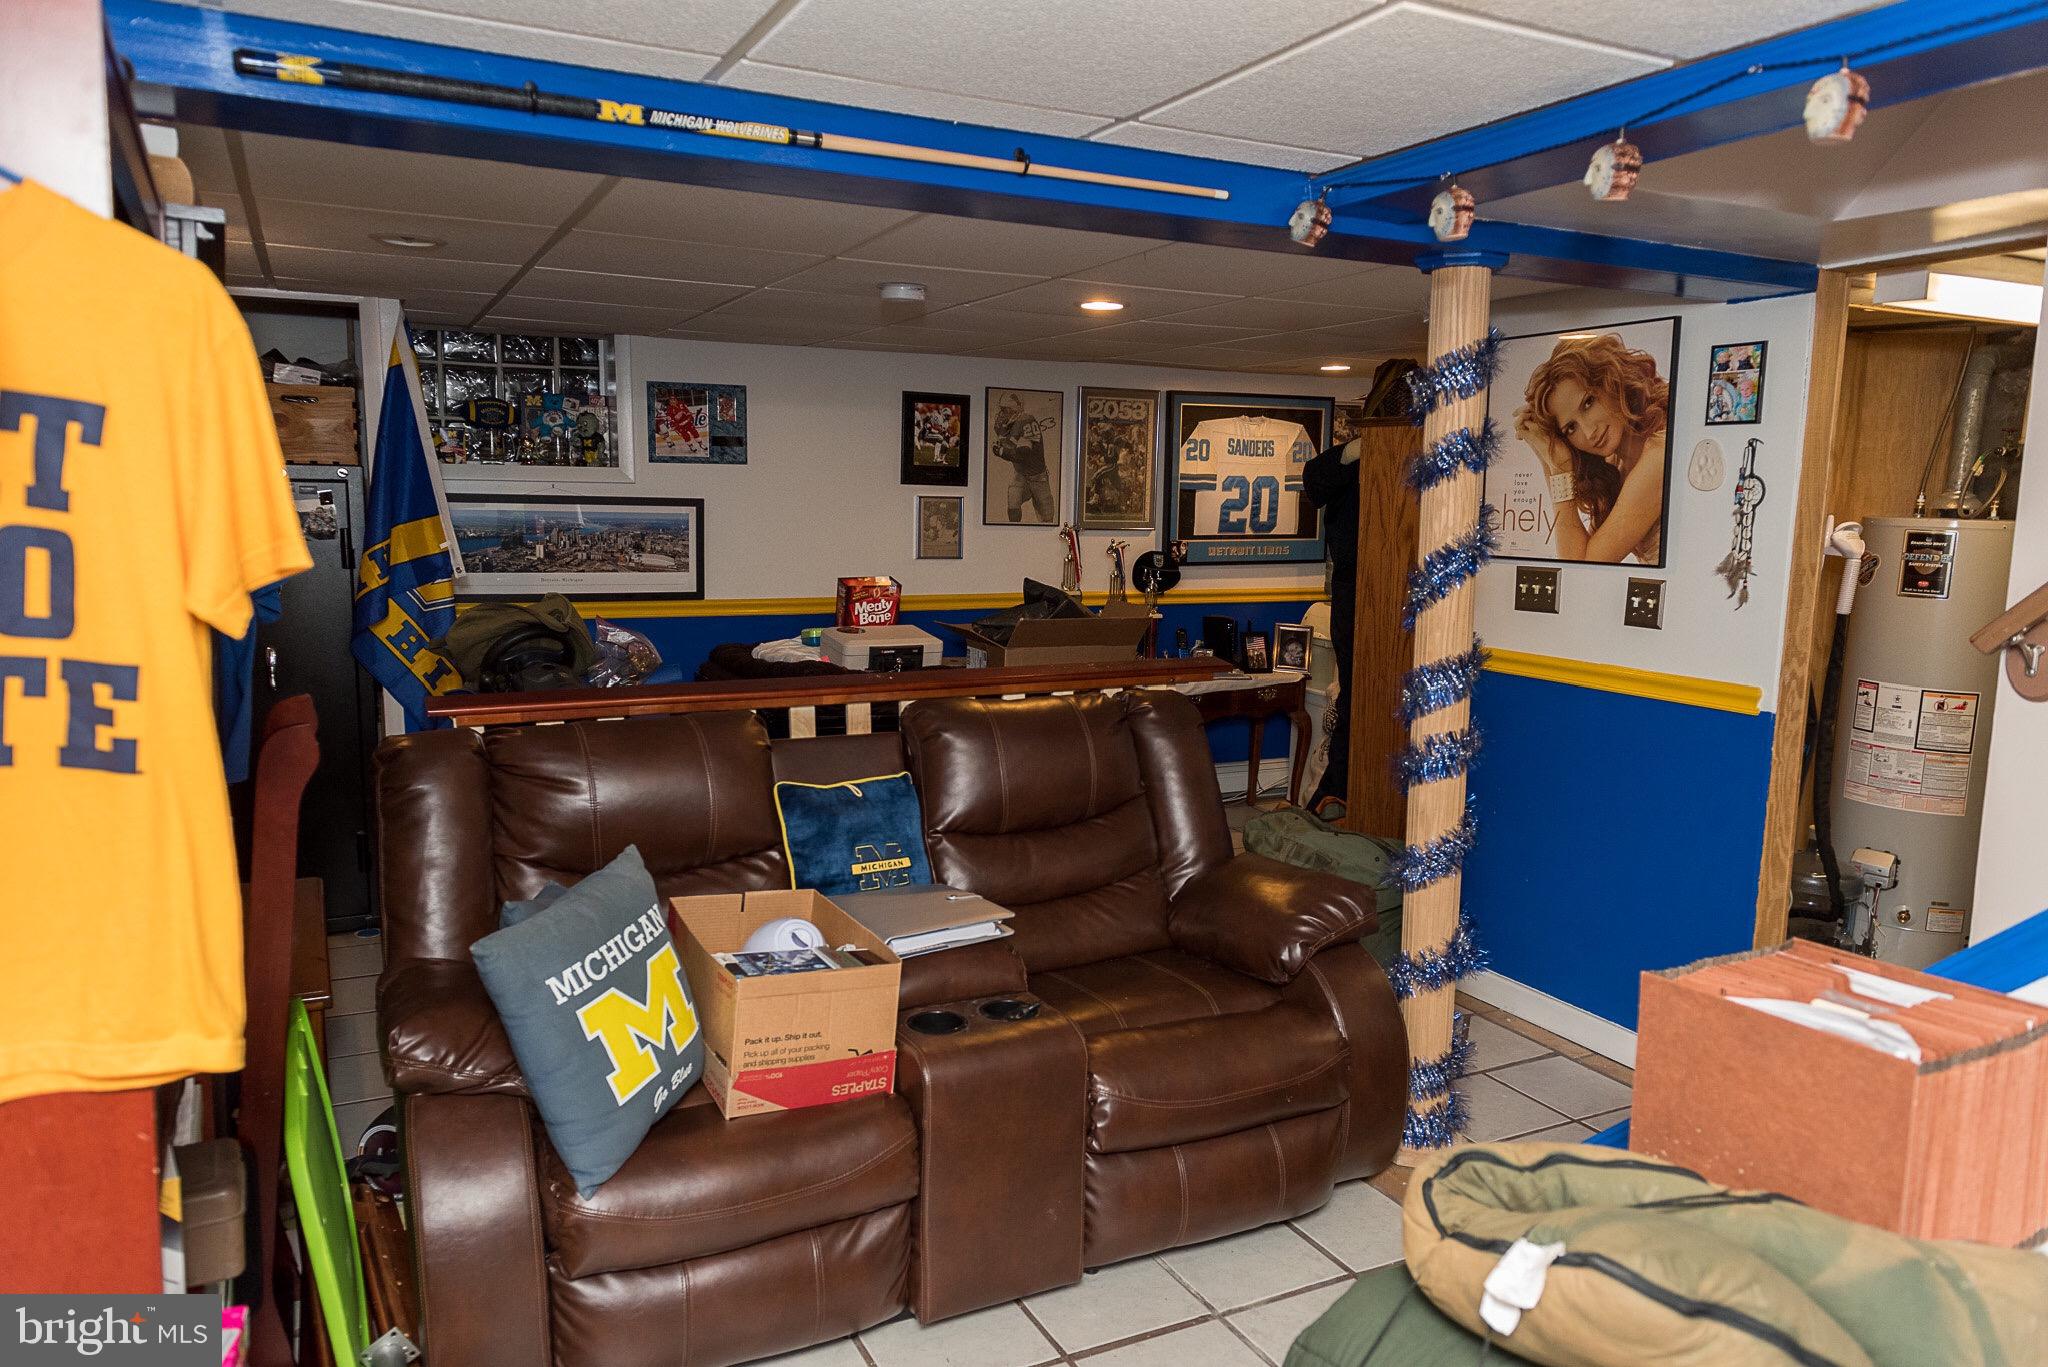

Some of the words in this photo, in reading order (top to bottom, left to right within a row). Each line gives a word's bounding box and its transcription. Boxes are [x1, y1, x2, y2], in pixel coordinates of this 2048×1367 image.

[596, 99, 646, 126] M
[650, 110, 713, 130] MICHIGAN
[714, 119, 786, 140] WOLVERINES
[1186, 438, 1210, 462] 20
[1227, 437, 1275, 458] SANDERS
[1217, 475, 1280, 534] 20
[1513, 496, 1537, 504] enough
[1486, 493, 1561, 545] chely
[1207, 545, 1255, 557] DETROIT
[854, 598, 893, 615] Meaty
[859, 611, 892, 626] Bone
[859, 859, 904, 872] MICHIGAN
[544, 903, 667, 1006] MICHIGAN
[575, 941, 700, 1107] M
[744, 1038, 763, 1046] Pack
[784, 1033, 801, 1043] Ship
[743, 1050, 758, 1058] Pick
[787, 1045, 803, 1055] your
[803, 1043, 830, 1053] packing
[743, 1060, 757, 1068] and
[758, 1057, 787, 1066] shipping
[831, 1076, 888, 1096] STAPLES
